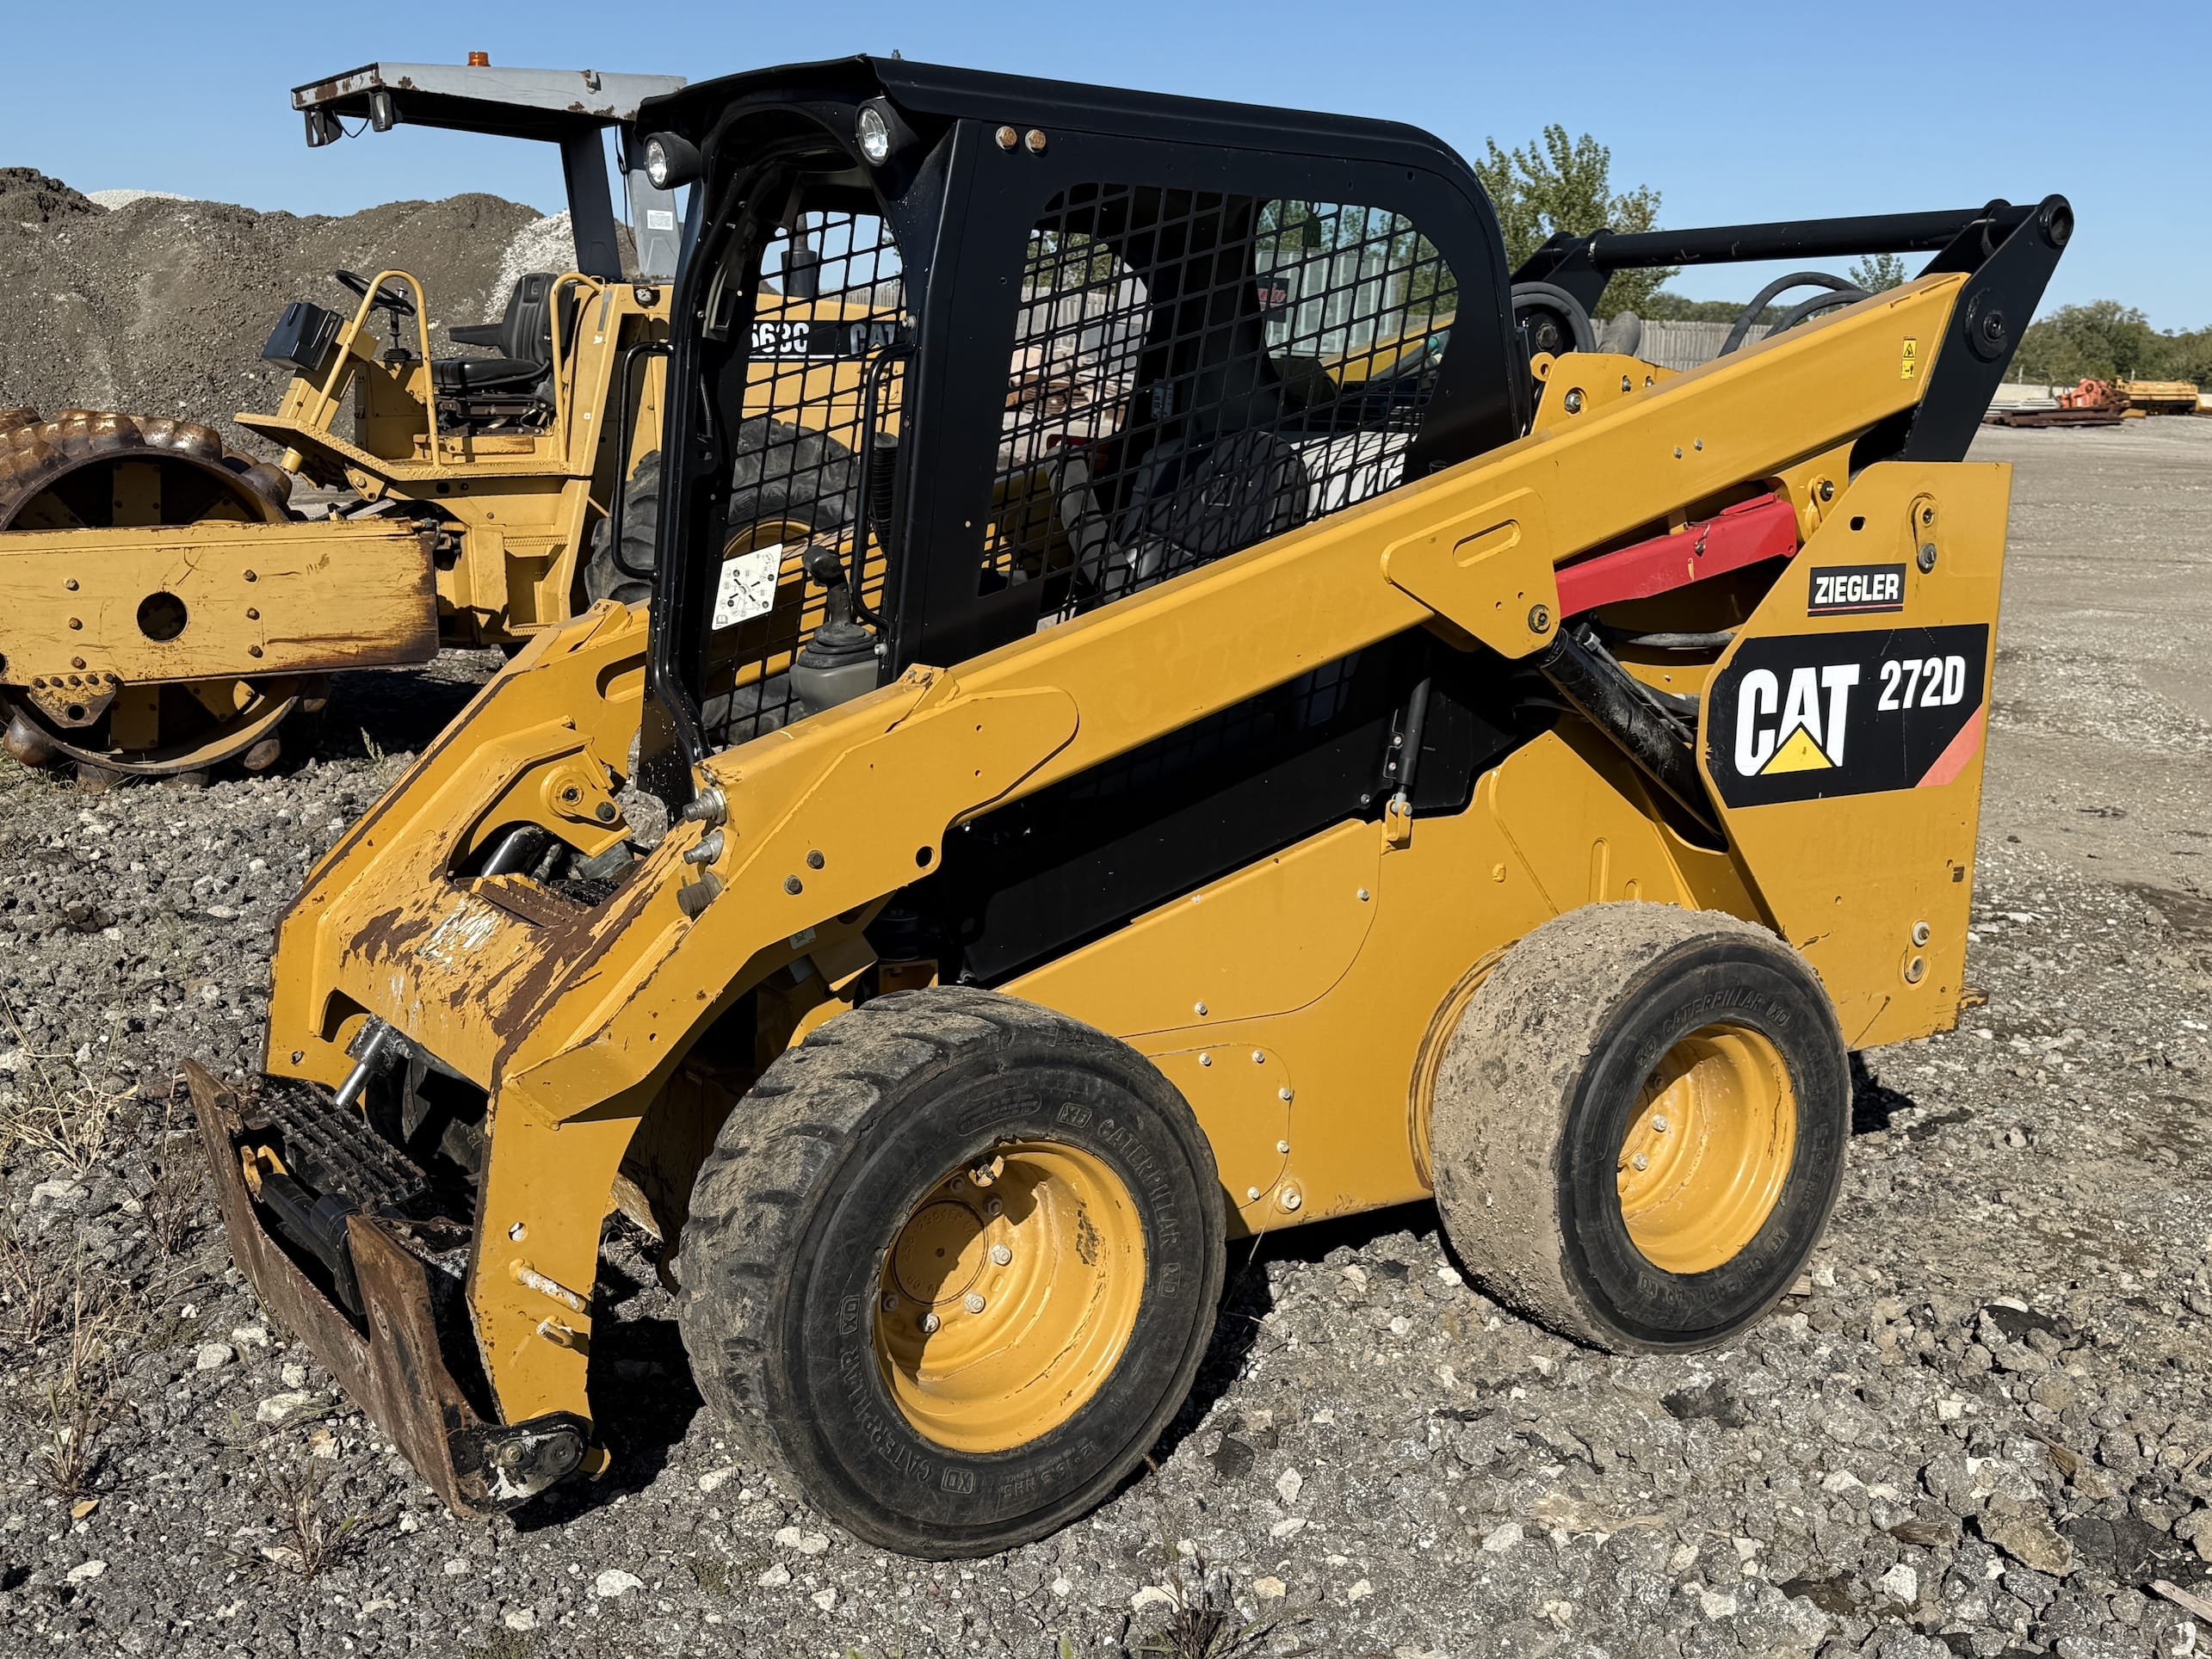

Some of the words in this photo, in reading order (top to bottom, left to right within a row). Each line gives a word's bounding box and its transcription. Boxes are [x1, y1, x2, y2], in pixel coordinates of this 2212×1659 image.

[1814, 573, 1900, 604] ZIEGLER
[1733, 663, 1861, 777] CAT
[1877, 655, 1966, 712] 272D
[1662, 990, 1765, 1034] CATERPILLAR
[1767, 1002, 1791, 1027] XD
[1060, 1103, 1091, 1127] XD
[1097, 1118, 1182, 1248] CATERPILLAR
[840, 1296, 860, 1335] XD
[840, 1344, 932, 1483] CATERPILLAR
[942, 1468, 975, 1493] XD
